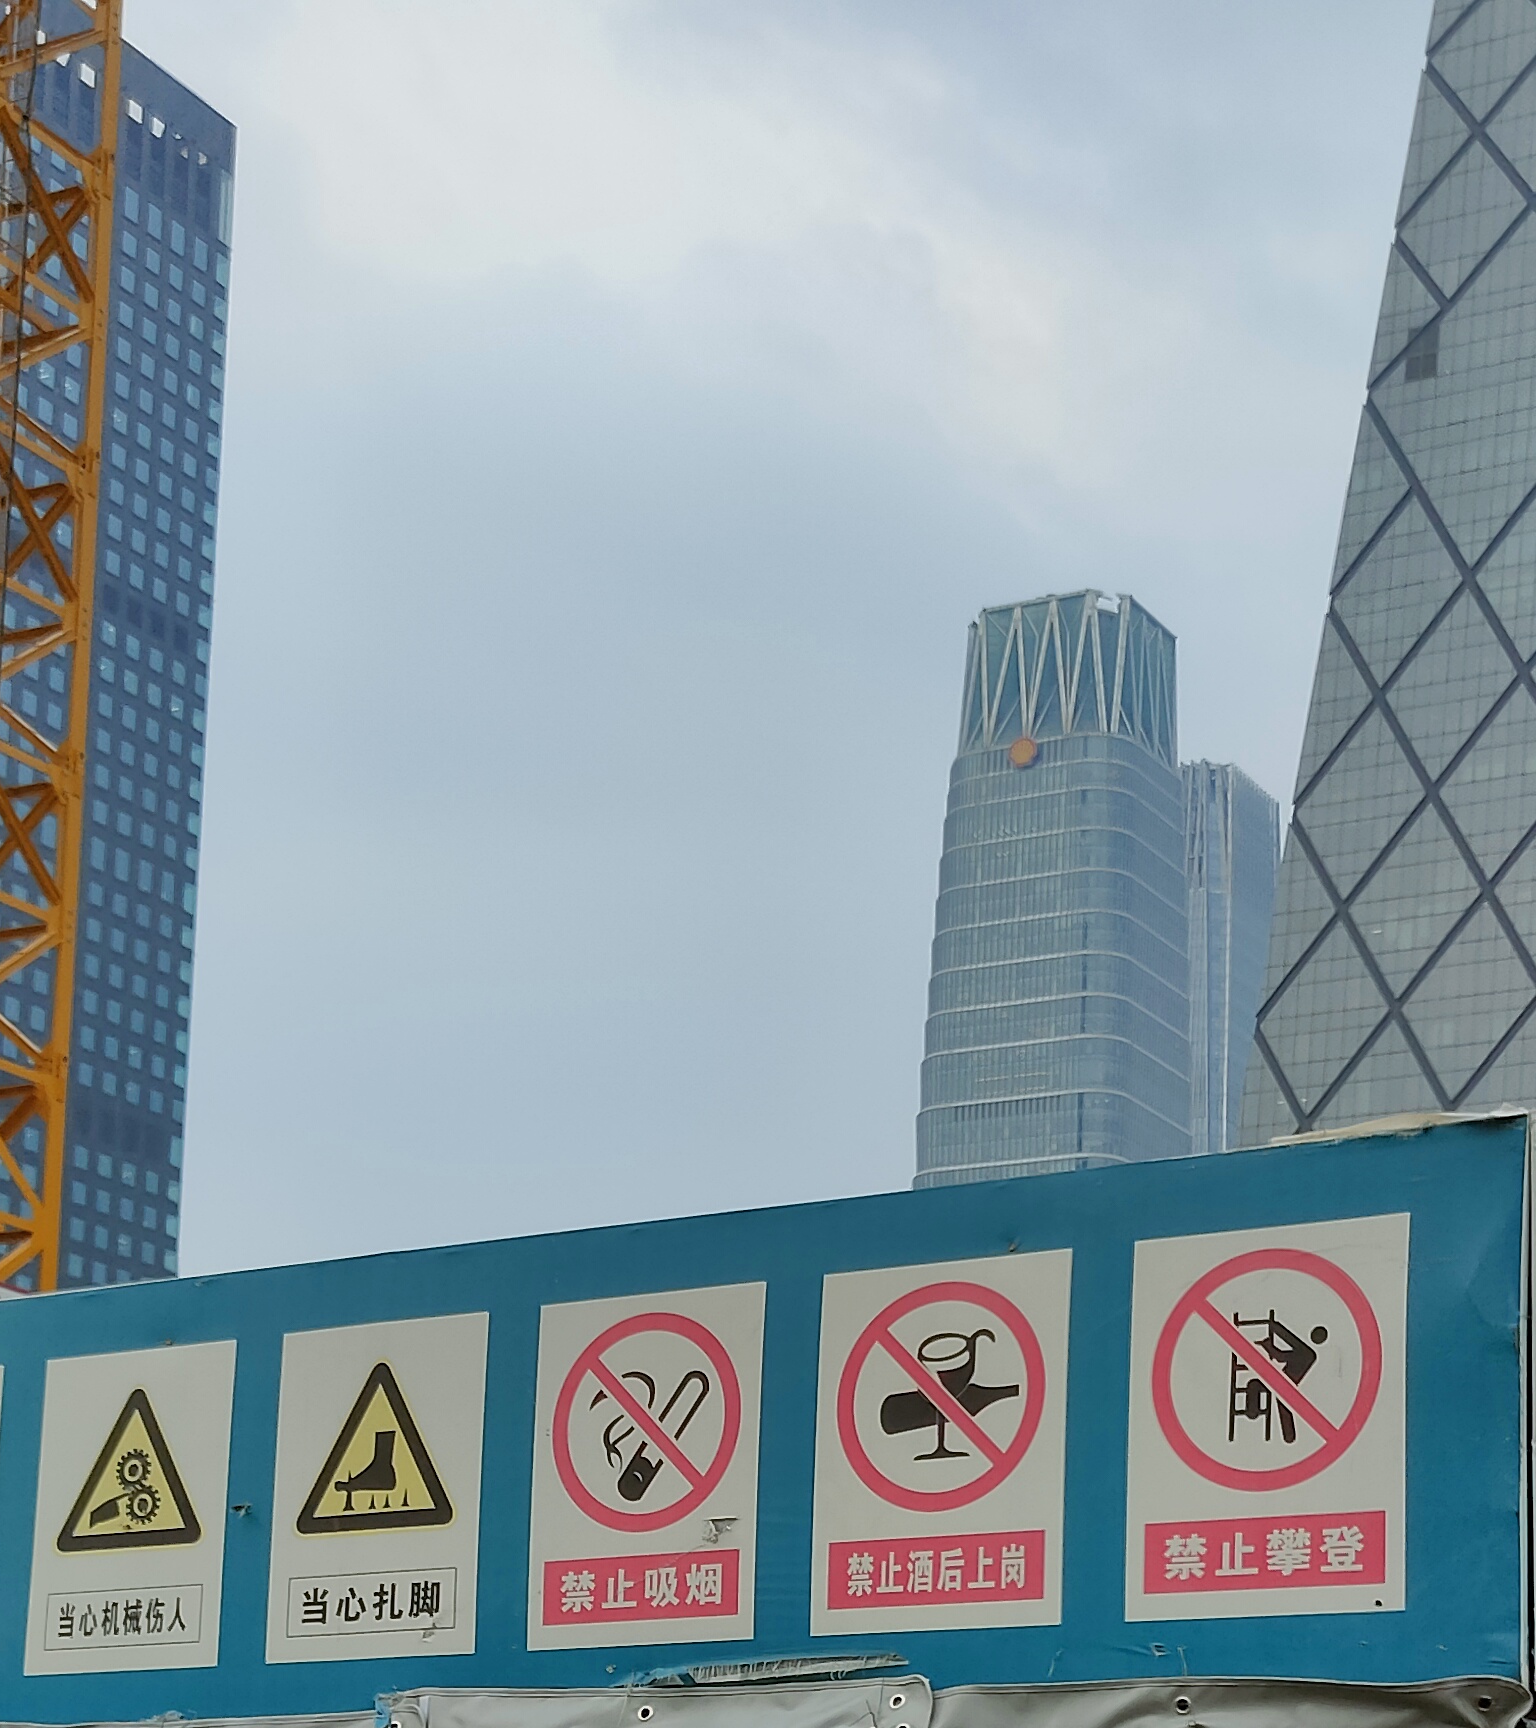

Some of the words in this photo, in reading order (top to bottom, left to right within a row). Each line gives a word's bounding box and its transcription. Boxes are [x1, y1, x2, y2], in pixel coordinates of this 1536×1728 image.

[845, 1543, 1026, 1595] 禁止酒后上岗
[1164, 1526, 1365, 1581] 禁止攀登
[300, 1581, 442, 1626] 当心扎脚
[559, 1561, 723, 1614] 禁止吸烟
[56, 1596, 187, 1640] 当心机械伤人
